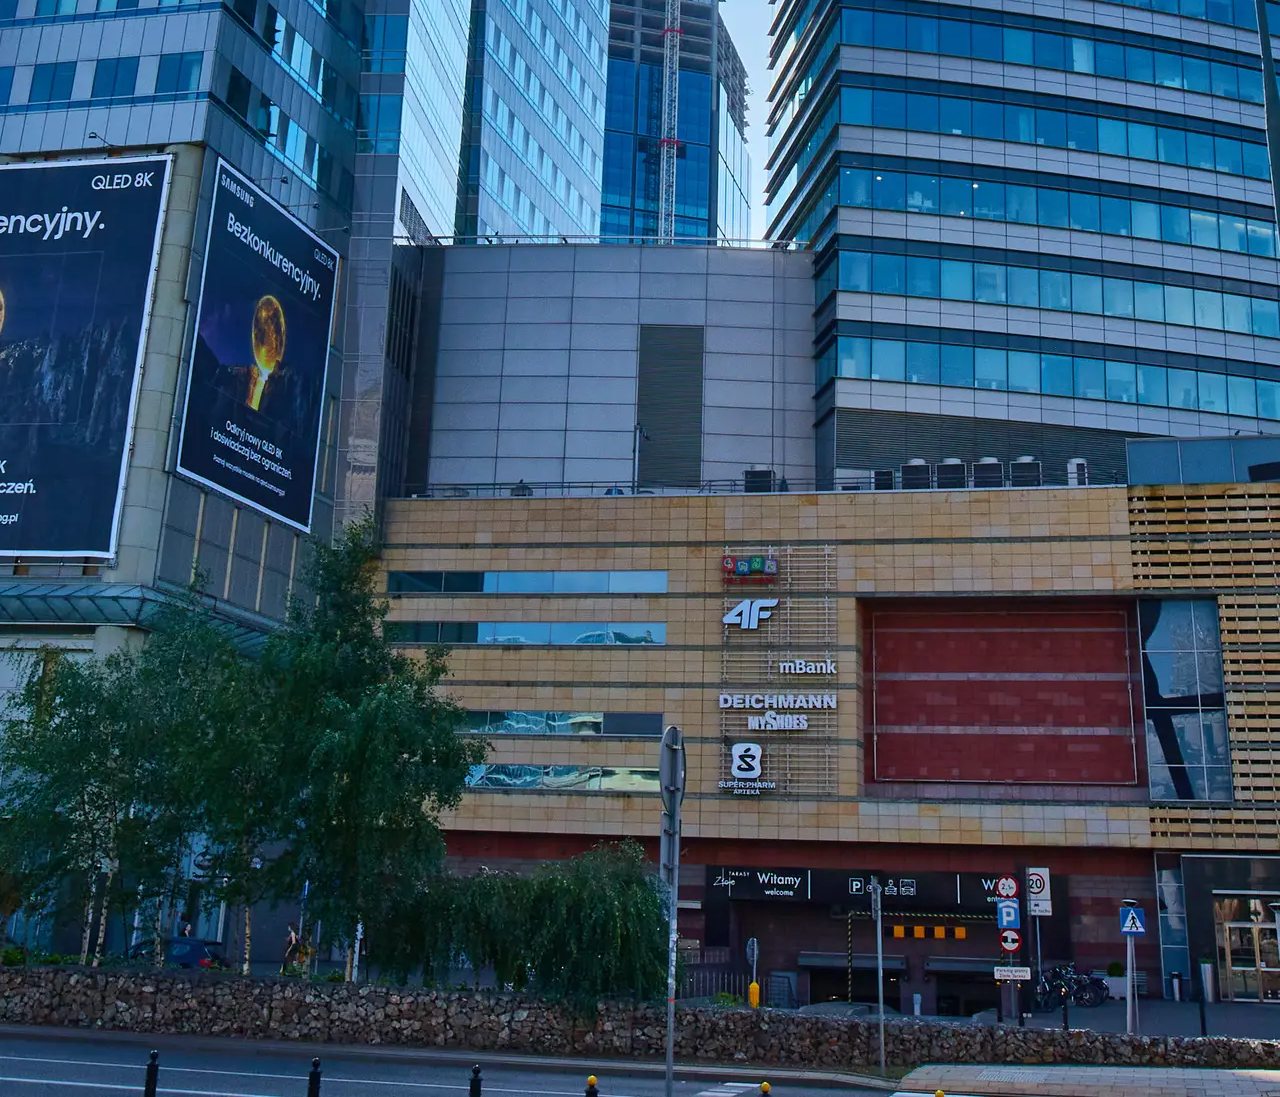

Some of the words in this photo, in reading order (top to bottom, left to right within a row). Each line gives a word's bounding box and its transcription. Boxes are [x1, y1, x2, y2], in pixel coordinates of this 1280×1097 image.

[91, 174, 131, 190] QLED
[134, 172, 155, 188] 8K
[221, 174, 254, 208] SAMSUNG
[227, 212, 321, 301] Bezkonkurencyjny.
[722, 598, 779, 630] 4F
[779, 660, 838, 674] mBank
[720, 694, 837, 708] DEICHMANN
[718, 781, 776, 789] SUPER-PHARM
[757, 872, 801, 888] Witamy
[1030, 879, 1042, 890] 20
[764, 888, 794, 896] welcome
